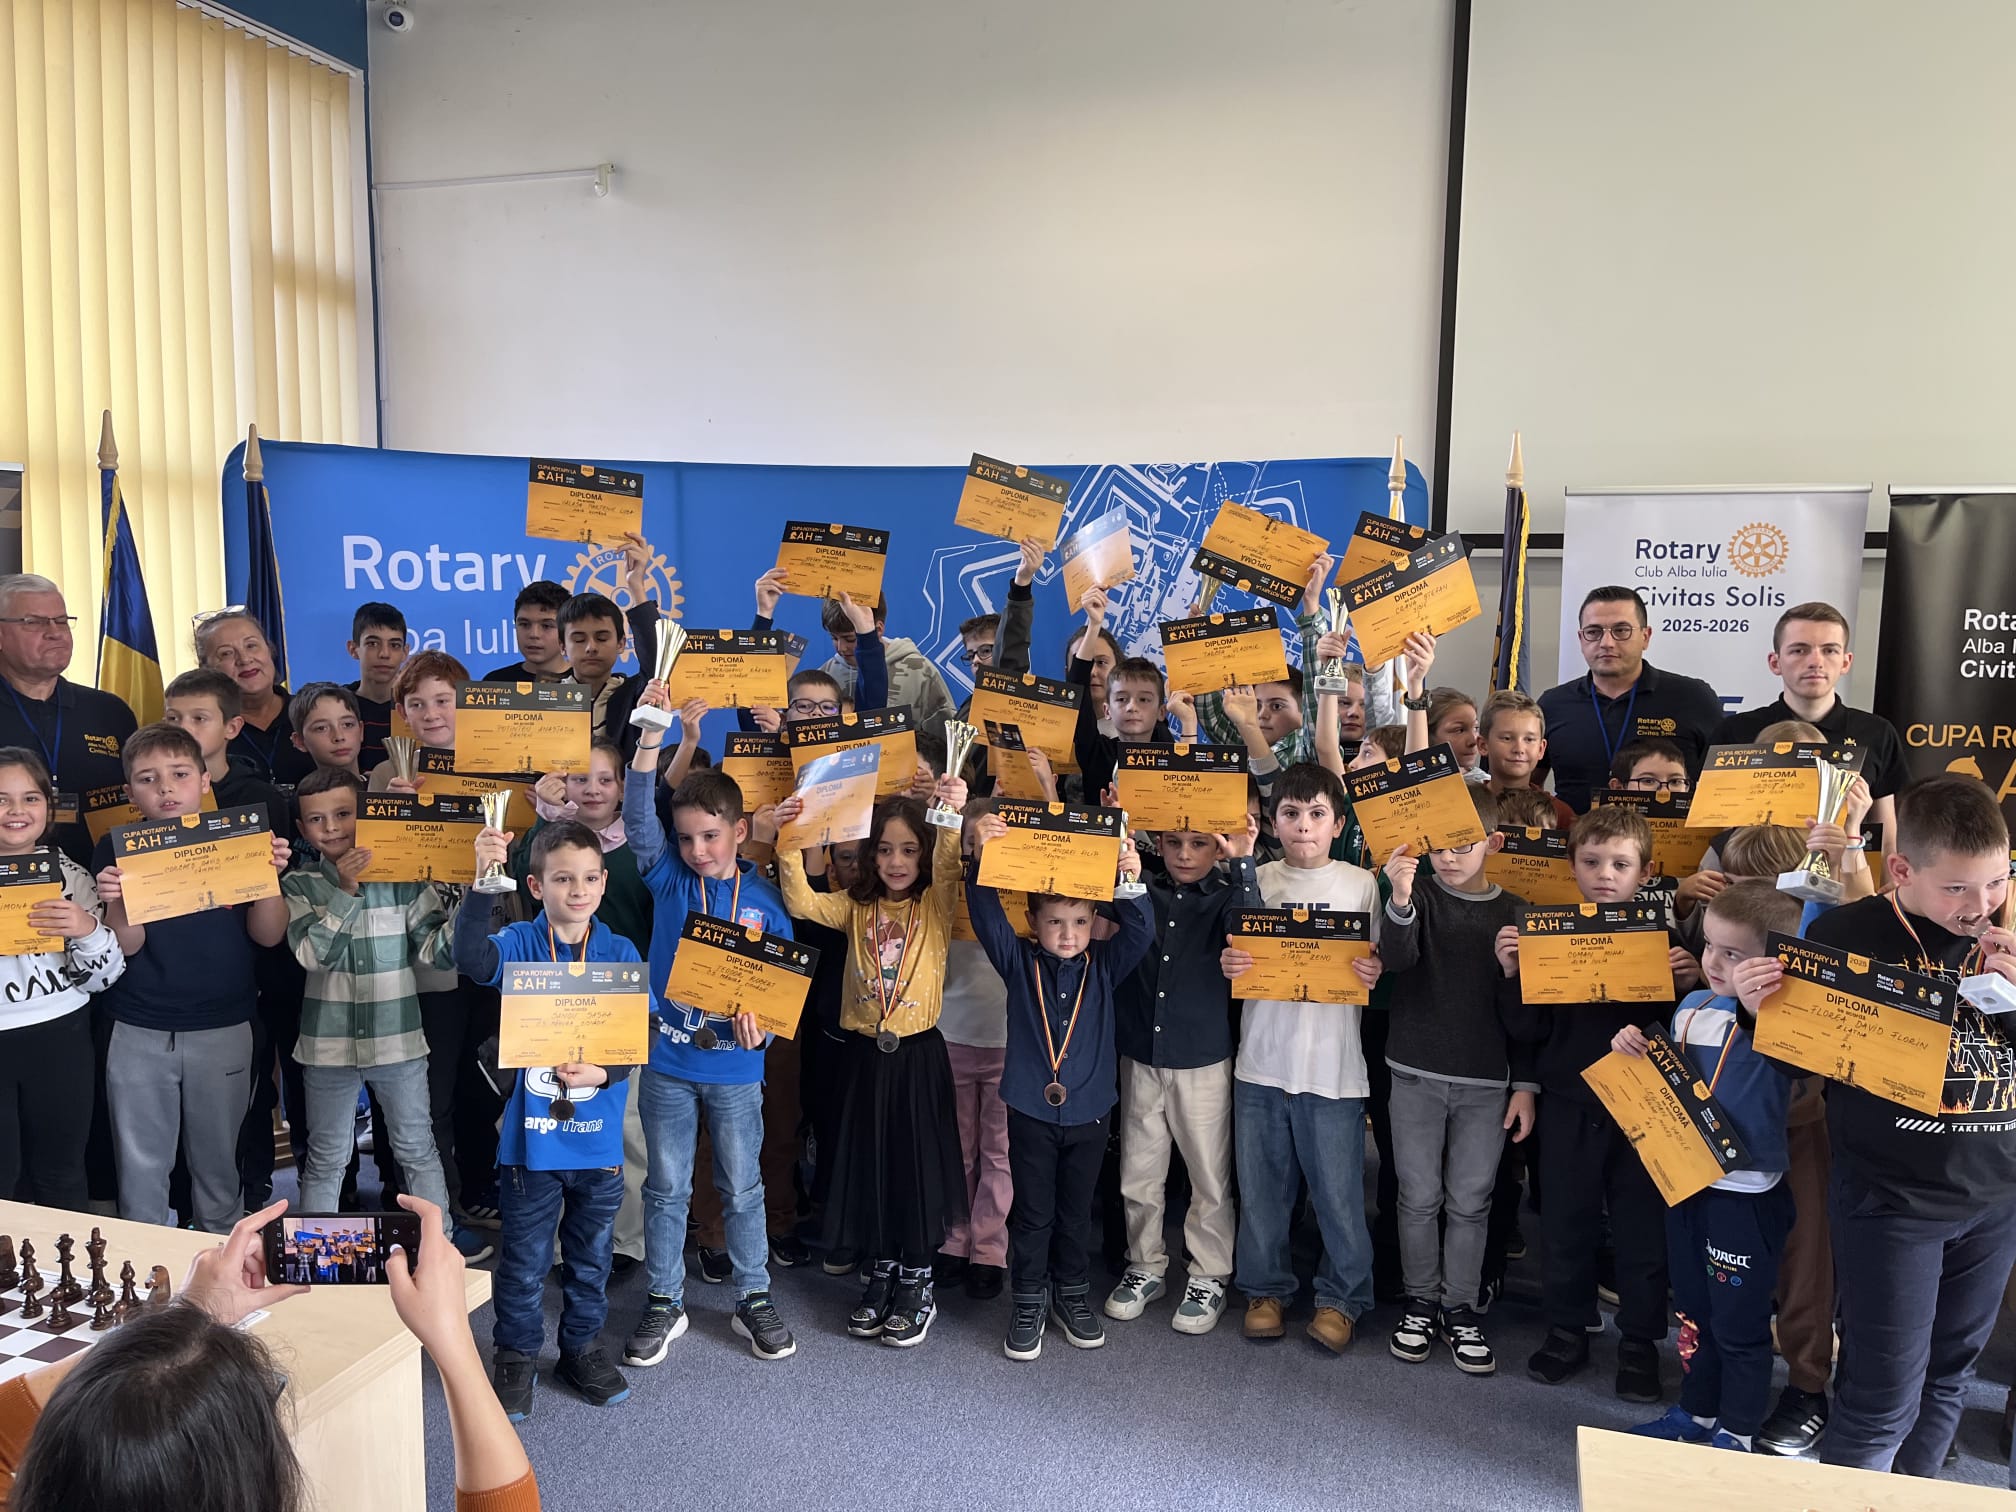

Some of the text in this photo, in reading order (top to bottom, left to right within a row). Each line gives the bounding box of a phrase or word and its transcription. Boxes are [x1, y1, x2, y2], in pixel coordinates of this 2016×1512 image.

[1635, 538, 1722, 564] Rotary
[343, 535, 547, 593] Rotary
[1634, 565, 1728, 578] Club Alba Iulia
[1393, 579, 1427, 602] DIPLOMĂ
[1633, 586, 1786, 606] Civitas Solis
[1662, 619, 1750, 632] 2025-2026
[464, 619, 517, 655] Iuli
[1204, 636, 1238, 647] DIPLOMĂ
[1962, 638, 2005, 654] Alba
[1637, 717, 1662, 726] Rotary
[1906, 723, 1986, 748] CUPA
[1388, 787, 1421, 802] DIPLOMĂ
[1033, 833, 1070, 842] DIPLOMĂ
[173, 843, 218, 859] DIPLOMĂ
[1512, 858, 1550, 868] DIPLOMĂ
[1570, 936, 1613, 945] DIPLOMĂ
[1778, 942, 1798, 954] CUPA
[1798, 948, 1829, 963] ROTARY
[725, 955, 764, 972] DIPLOMĂ
[1849, 956, 1868, 968] 2025
[1877, 973, 1894, 983] Rotary
[555, 996, 596, 1005] DIPLOMĂ
[1826, 993, 1879, 1017] DIPLOMĂ
[1658, 1086, 1690, 1128] DIPLOMĂ
[562, 1118, 603, 1133] Trans
